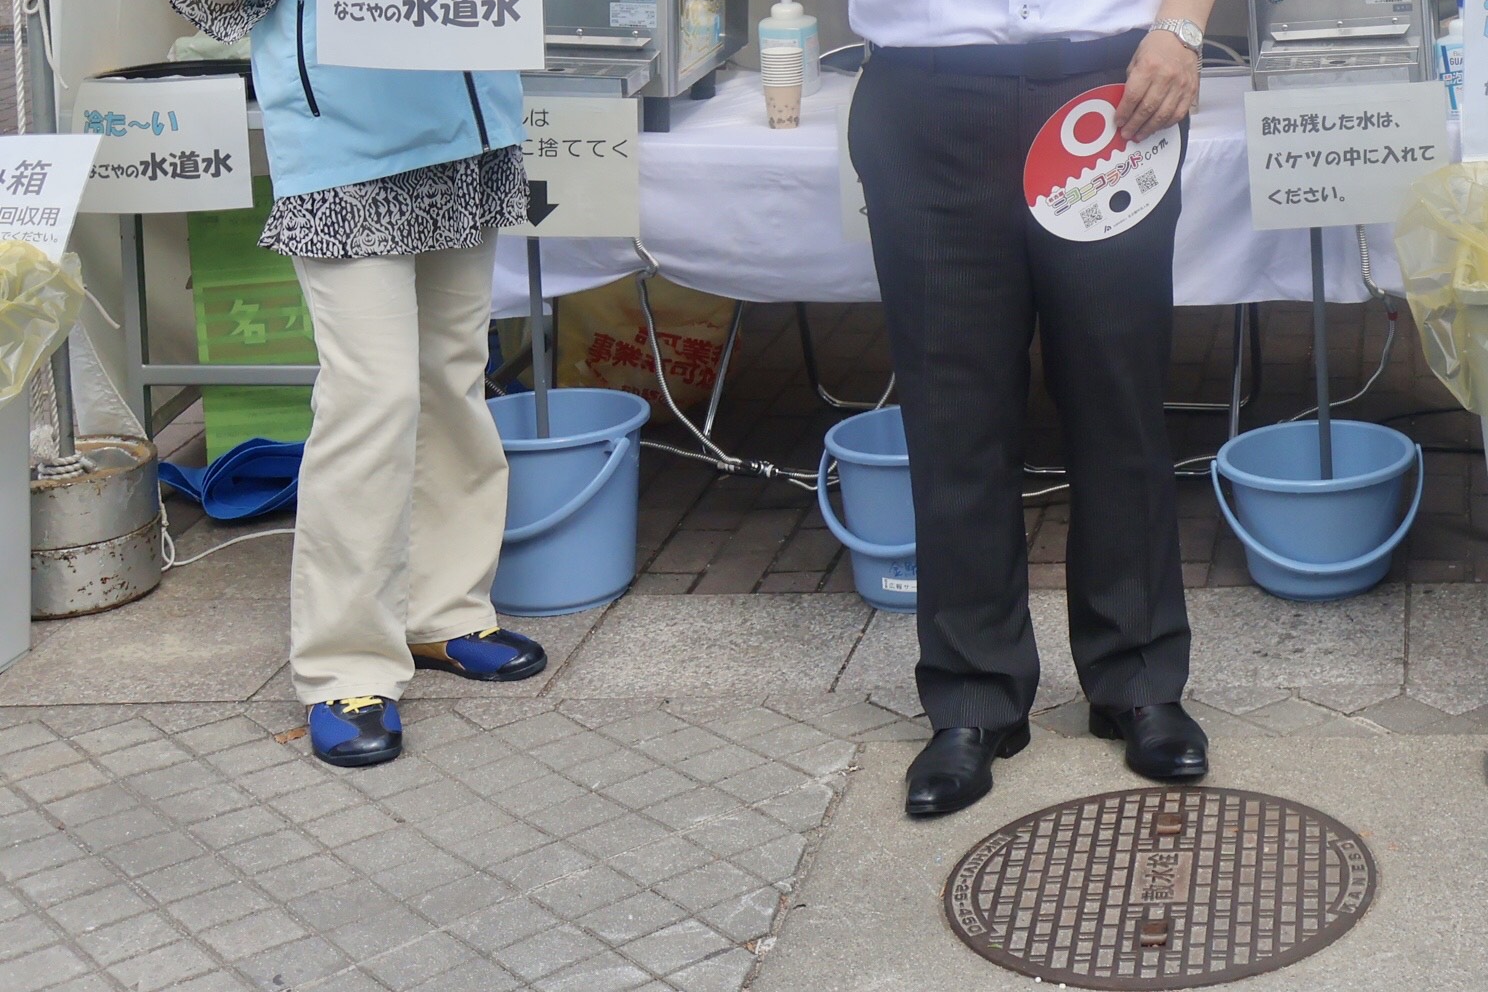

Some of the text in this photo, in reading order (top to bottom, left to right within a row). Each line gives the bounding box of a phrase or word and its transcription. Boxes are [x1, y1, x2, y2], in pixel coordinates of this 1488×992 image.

[1261, 111, 1401, 136] 飲み残した水は、
[1265, 144, 1435, 170] バケツの中に入れて
[0, 160, 52, 195] 箱
[1268, 185, 1346, 205] ください。
[1141, 853, 1179, 901] 散水栓
